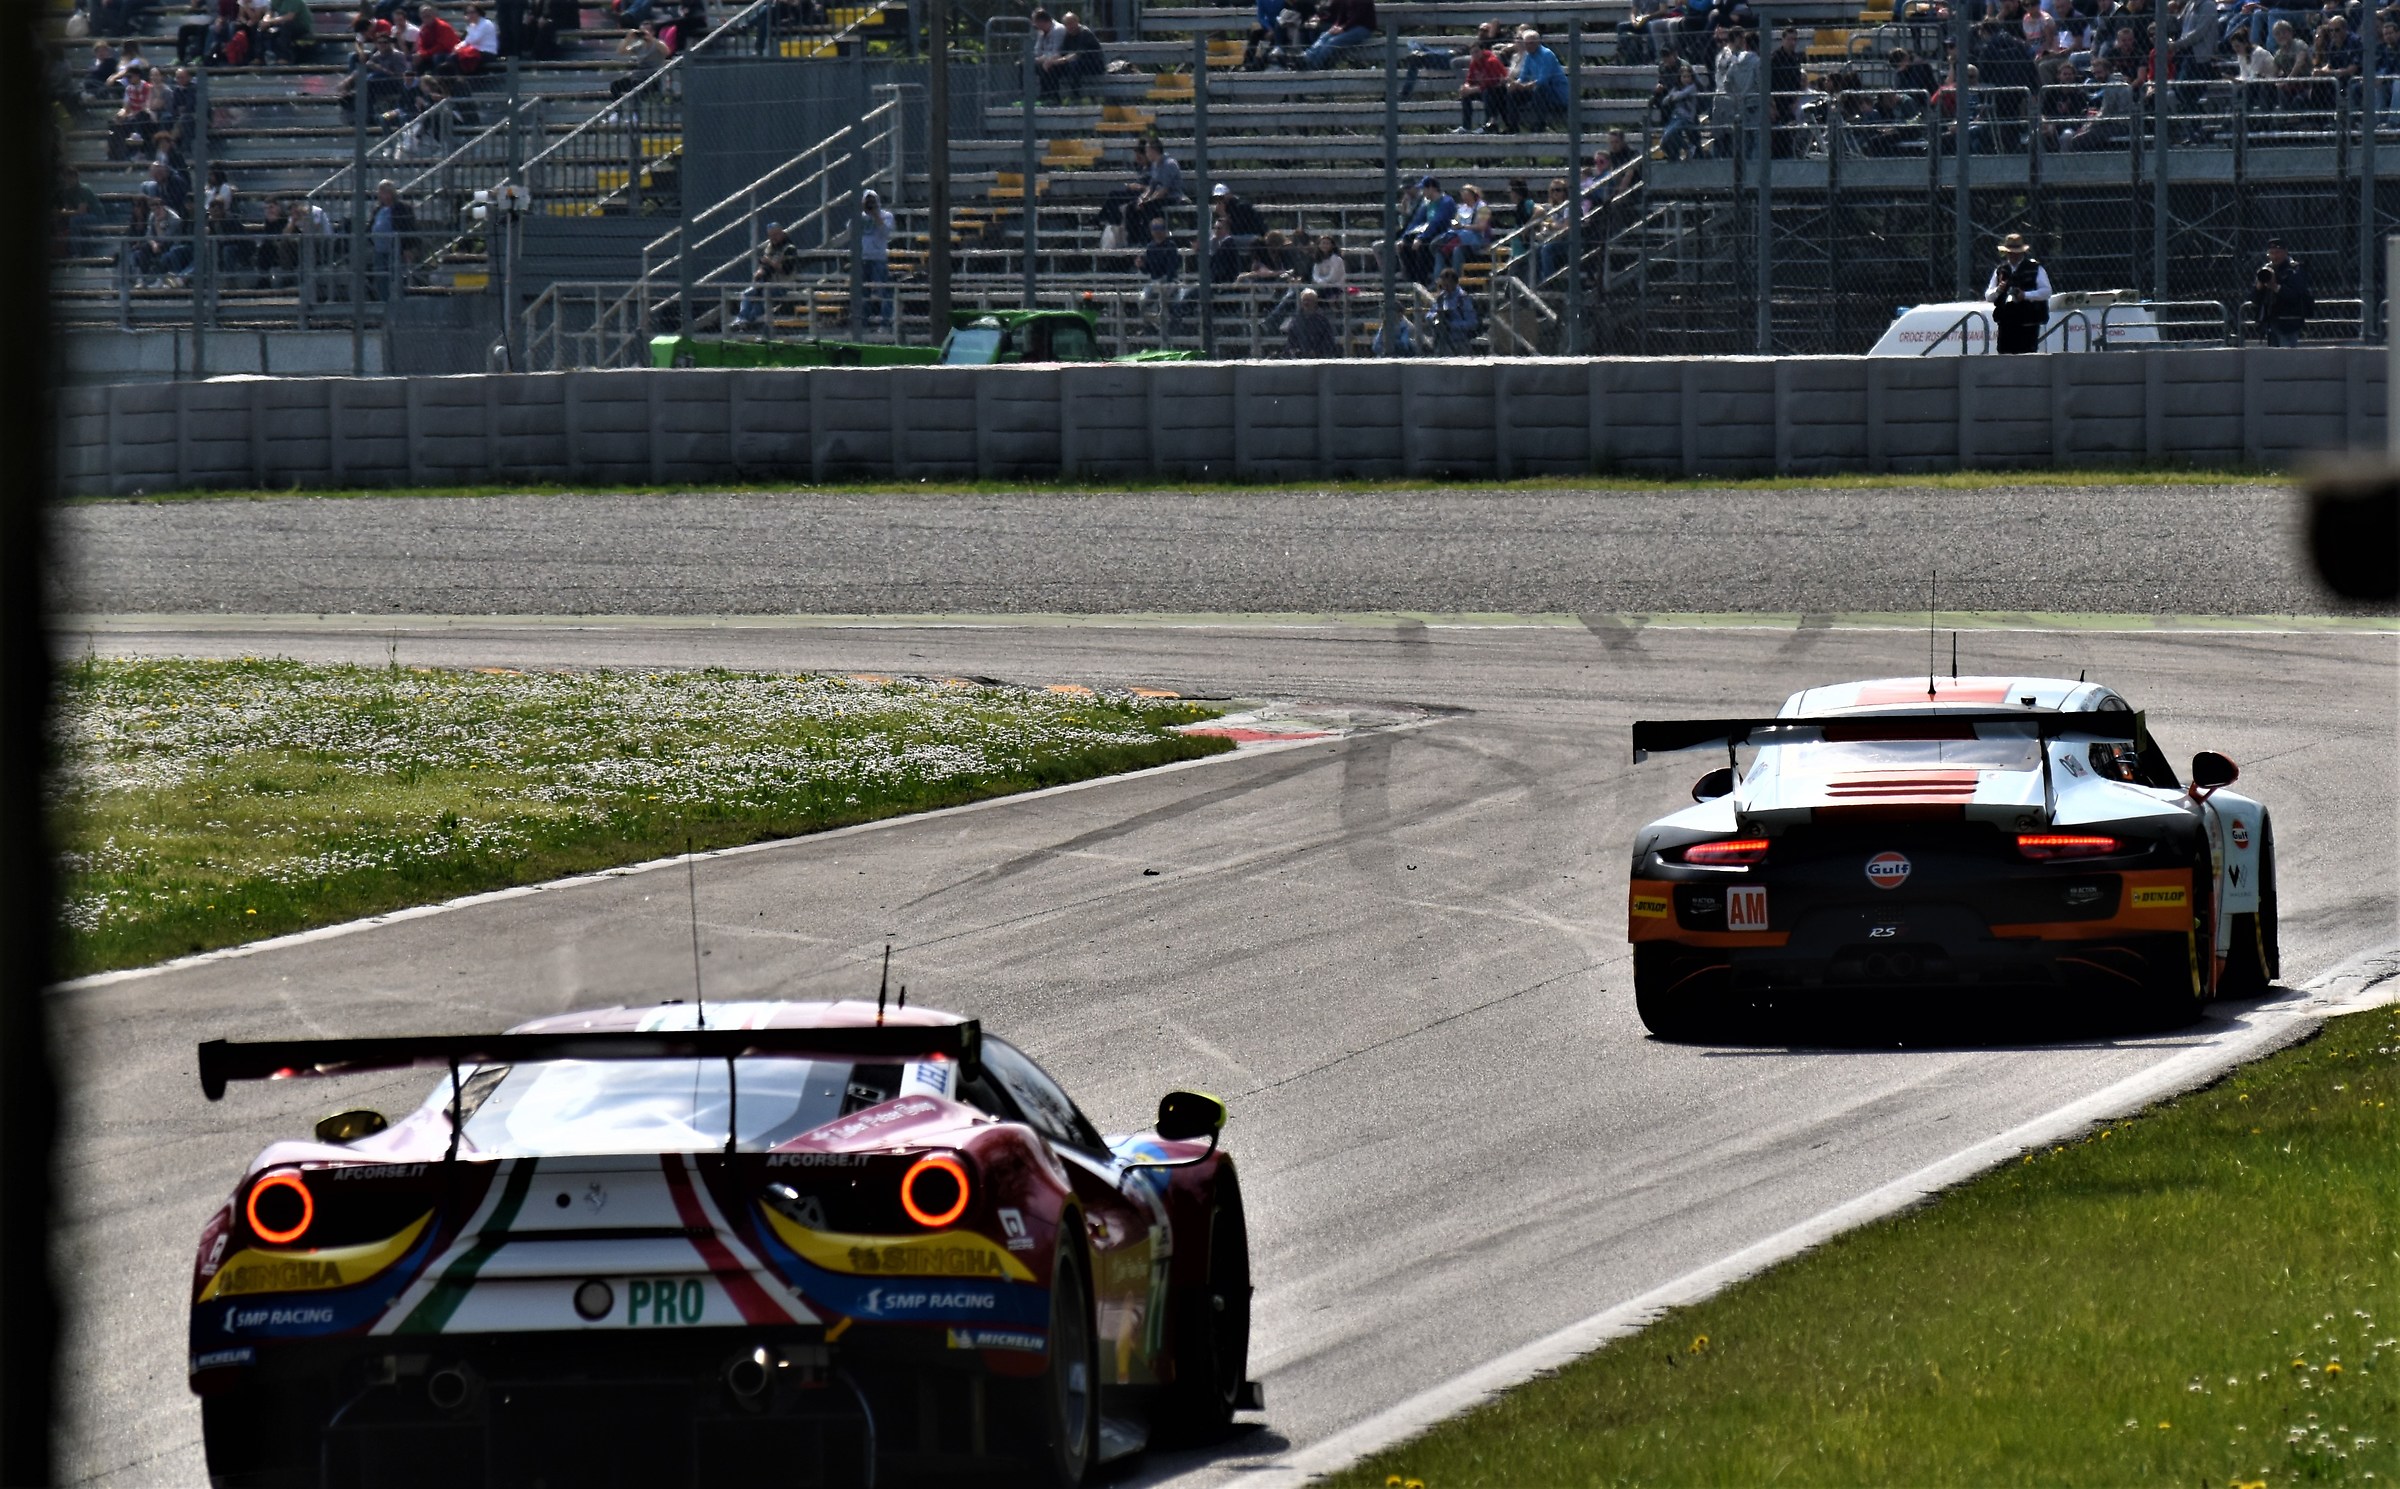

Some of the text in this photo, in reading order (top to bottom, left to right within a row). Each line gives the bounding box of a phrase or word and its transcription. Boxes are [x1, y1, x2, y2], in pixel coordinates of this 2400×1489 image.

[1899, 331, 1924, 343] CROCE
[2232, 830, 2248, 839] Gulf
[1867, 863, 1909, 874] Gulf
[2142, 891, 2185, 902] DUNLOP
[1638, 900, 1666, 912] DUNLOP
[1730, 893, 1766, 925] AM
[1869, 927, 1896, 938] RS
[766, 1154, 872, 1168] AFCORSE.IT
[333, 1163, 427, 1182] AFCORSE.IT
[881, 1247, 1004, 1274] SINGHA
[234, 1260, 344, 1292] SINGHA
[627, 1278, 705, 1326] PRO
[884, 1293, 995, 1310] SMP RACING
[236, 1307, 334, 1328] SMP RACING
[976, 1333, 1045, 1350] MICHELIN
[198, 1349, 251, 1367] MICHELIN
